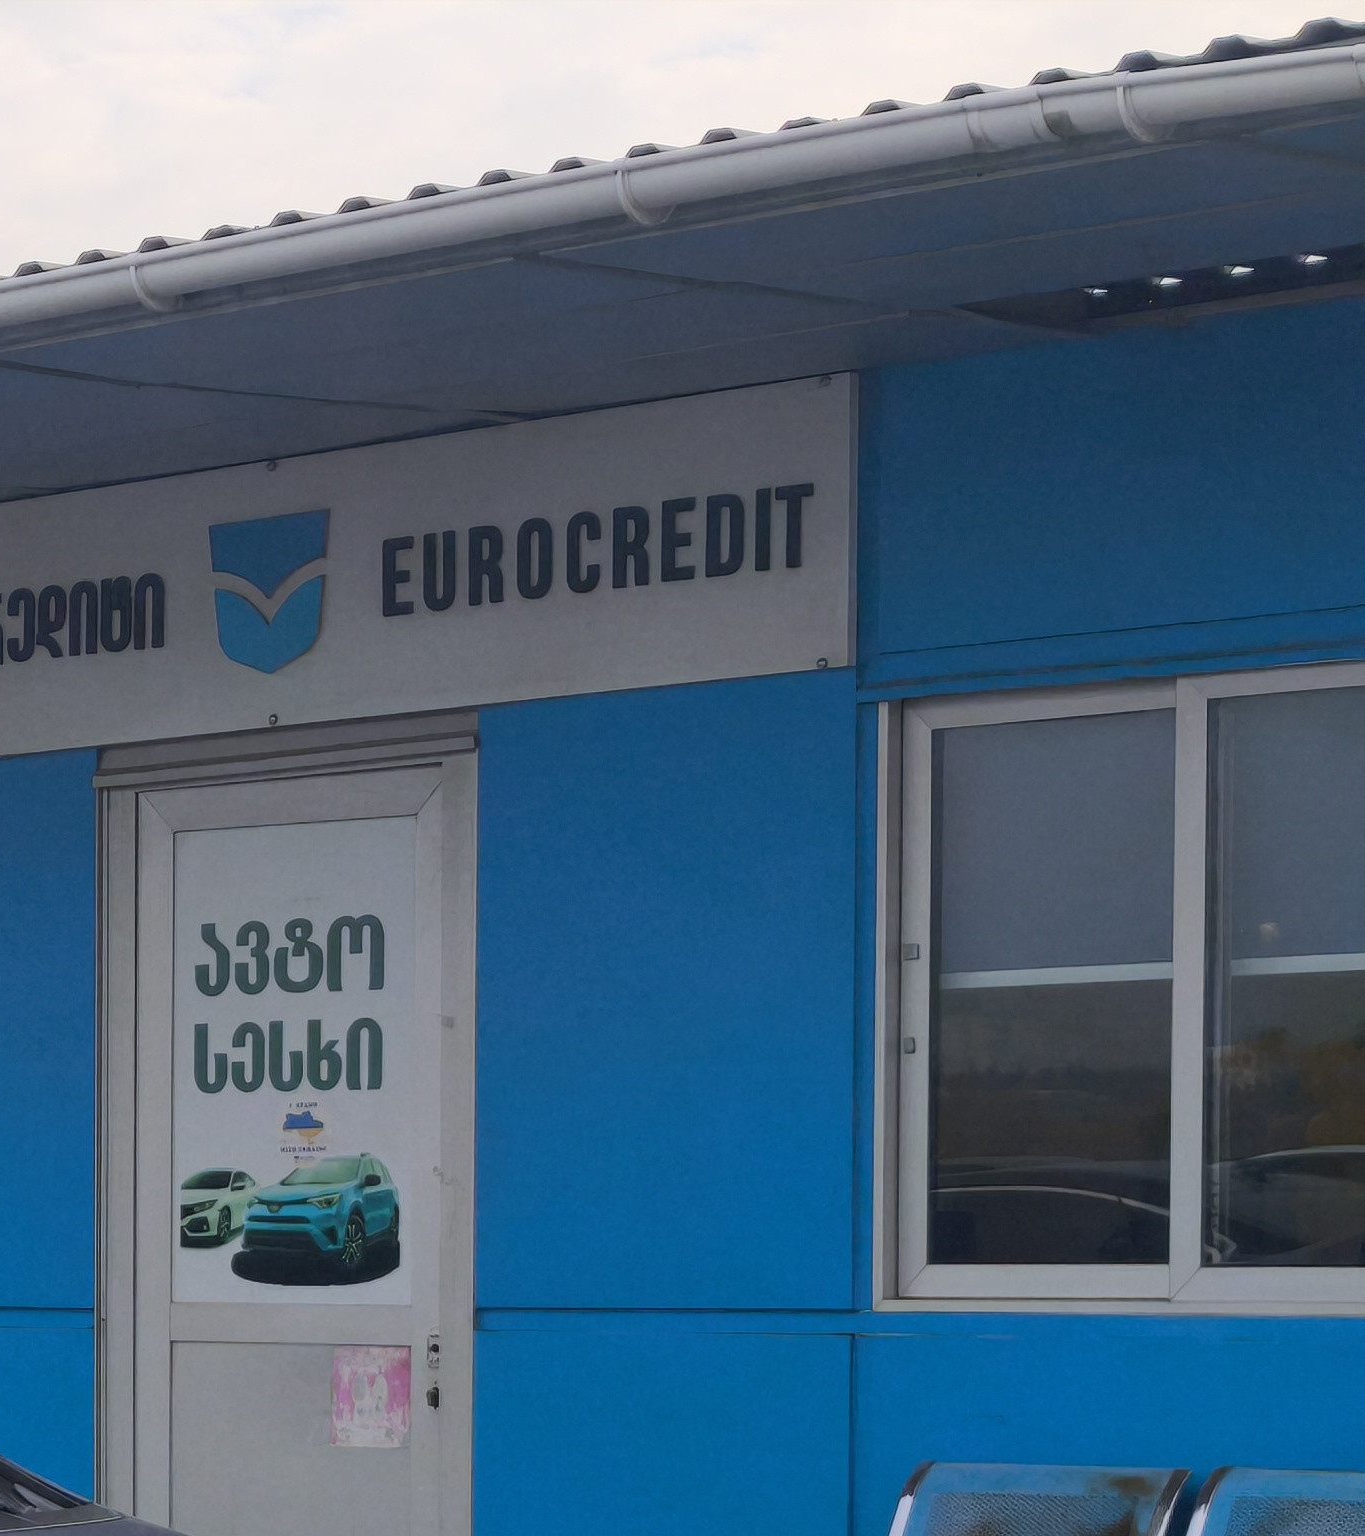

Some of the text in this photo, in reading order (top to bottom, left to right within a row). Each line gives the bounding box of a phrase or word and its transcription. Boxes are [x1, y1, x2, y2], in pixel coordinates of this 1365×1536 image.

[381, 482, 815, 617] EUROCREDIT
[194, 913, 385, 997] ავტო
[193, 1017, 383, 1094] სესხი
